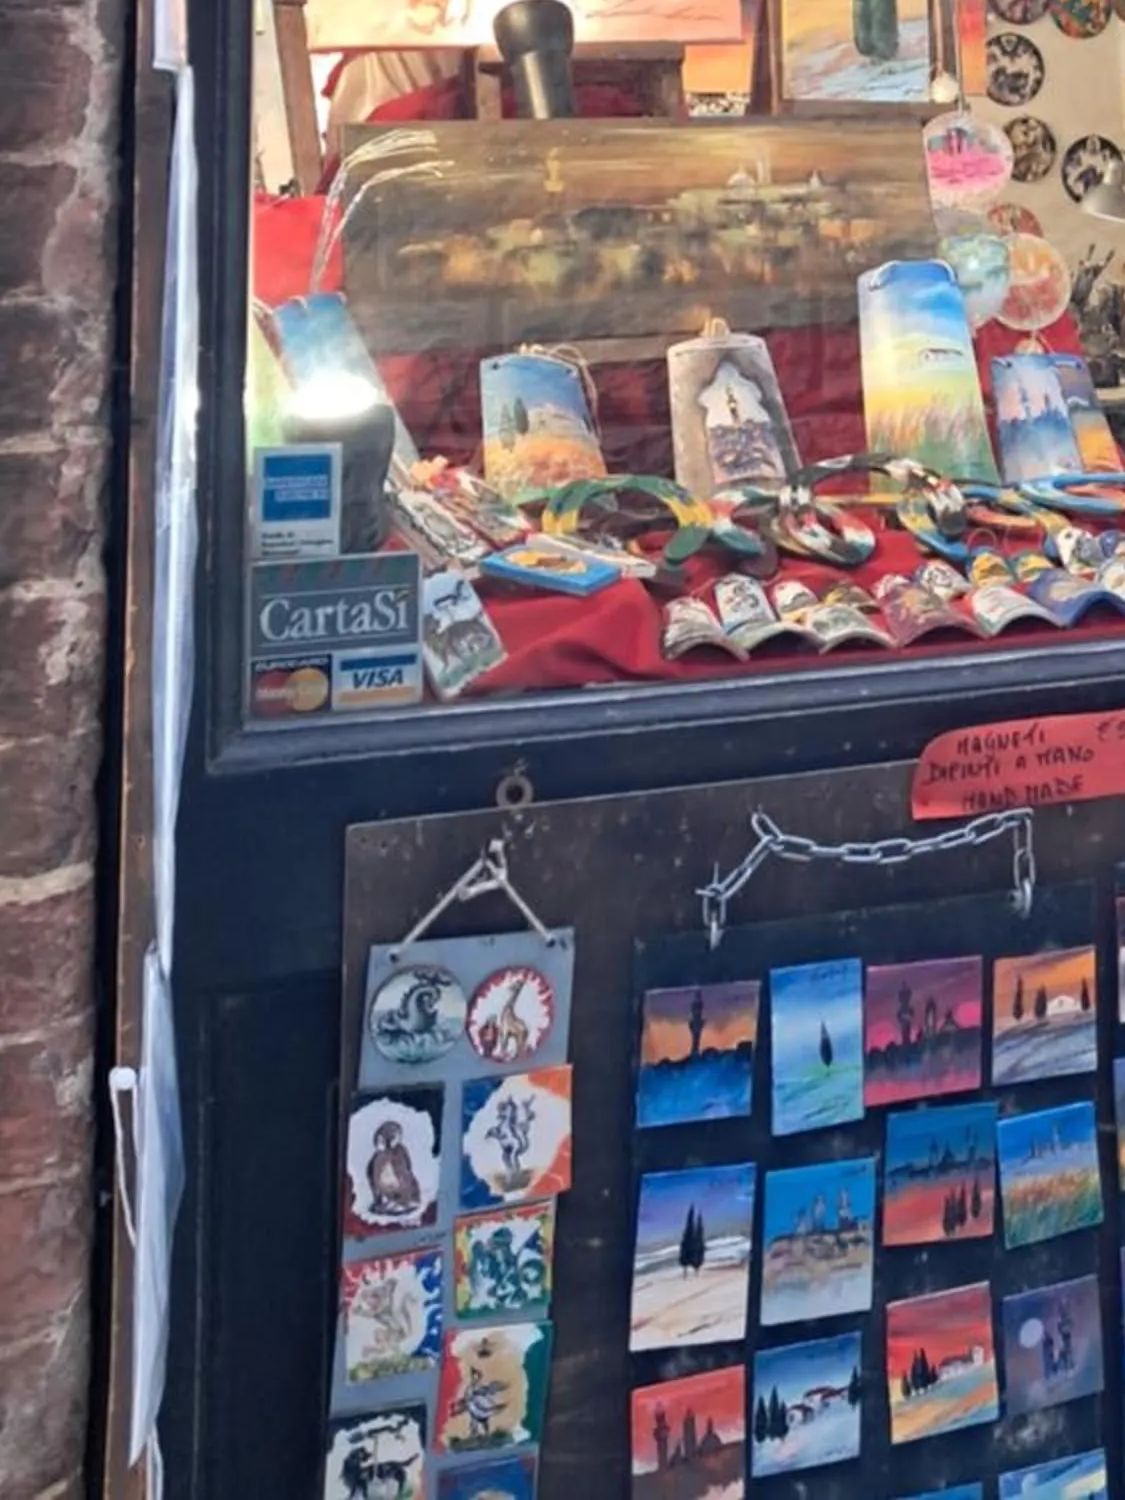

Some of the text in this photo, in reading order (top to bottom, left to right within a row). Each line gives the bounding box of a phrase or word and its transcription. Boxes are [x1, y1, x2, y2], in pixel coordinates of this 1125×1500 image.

[352, 668, 404, 689] VISA
[957, 723, 1045, 754] MAGNETI
[1037, 745, 1095, 767] MANO
[1026, 774, 1083, 802] MADE
